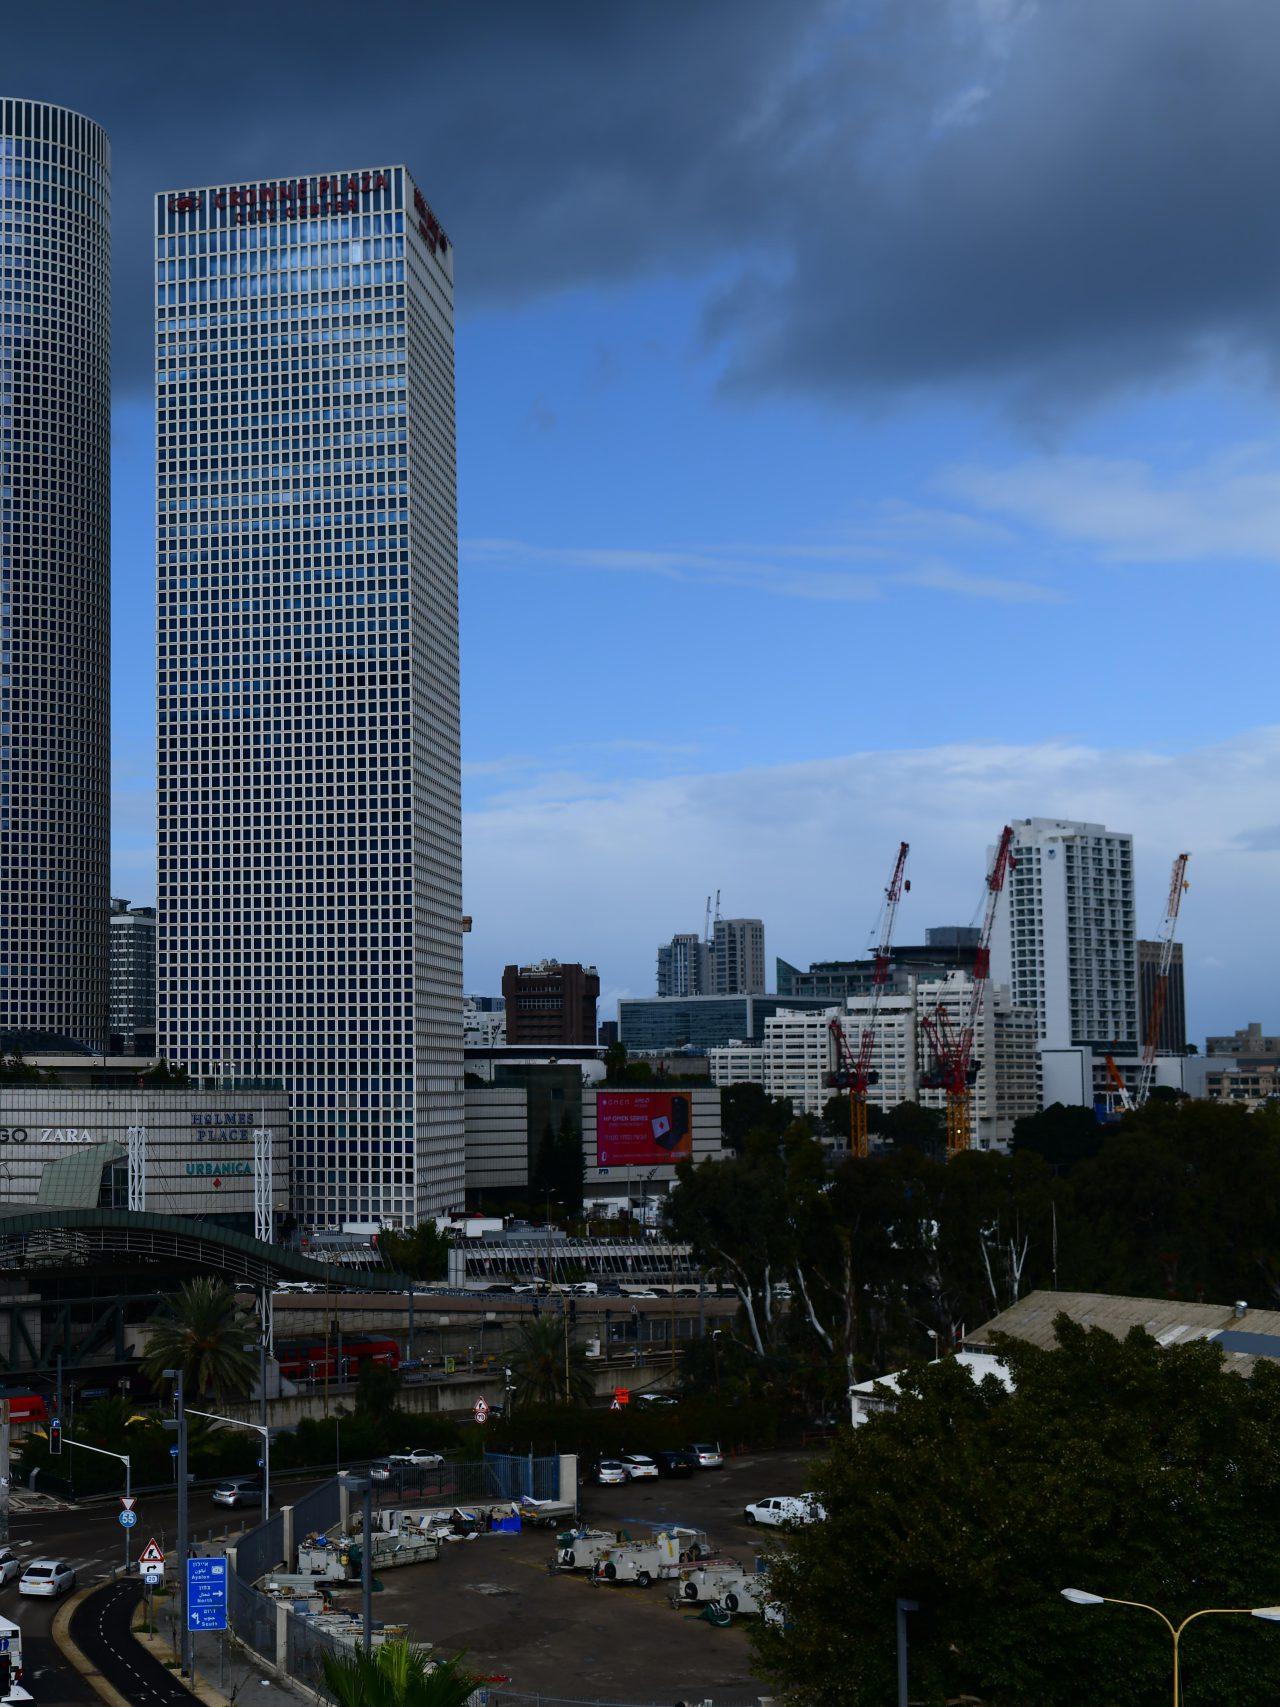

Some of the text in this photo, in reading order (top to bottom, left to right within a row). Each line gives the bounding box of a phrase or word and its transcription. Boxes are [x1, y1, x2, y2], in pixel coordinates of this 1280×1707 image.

[215, 174, 387, 209] CROWNE PLAZA
[40, 1128, 94, 1142] ZARA
[197, 1129, 249, 1141] PLACE
[185, 1162, 252, 1175] URBANICA
